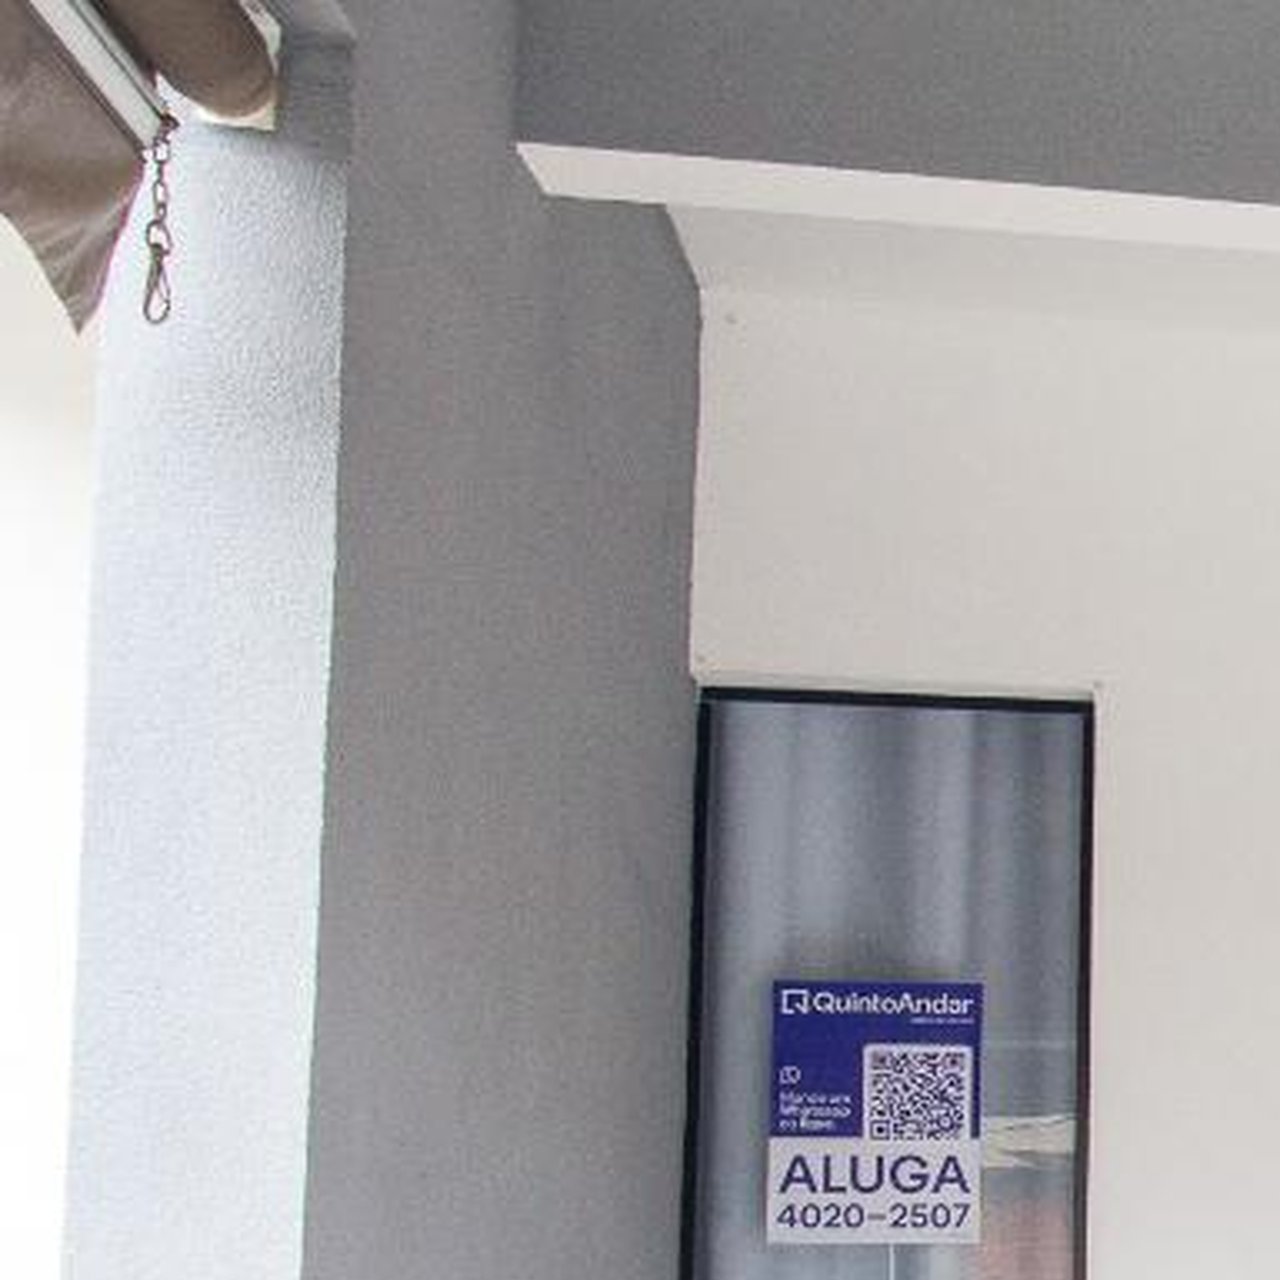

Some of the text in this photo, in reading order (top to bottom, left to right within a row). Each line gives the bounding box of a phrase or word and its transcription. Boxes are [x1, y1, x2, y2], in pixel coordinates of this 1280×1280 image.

[812, 991, 975, 1014] QuintoAndar
[778, 1154, 971, 1194] ALUGA
[776, 1202, 971, 1229] 4020-2507
